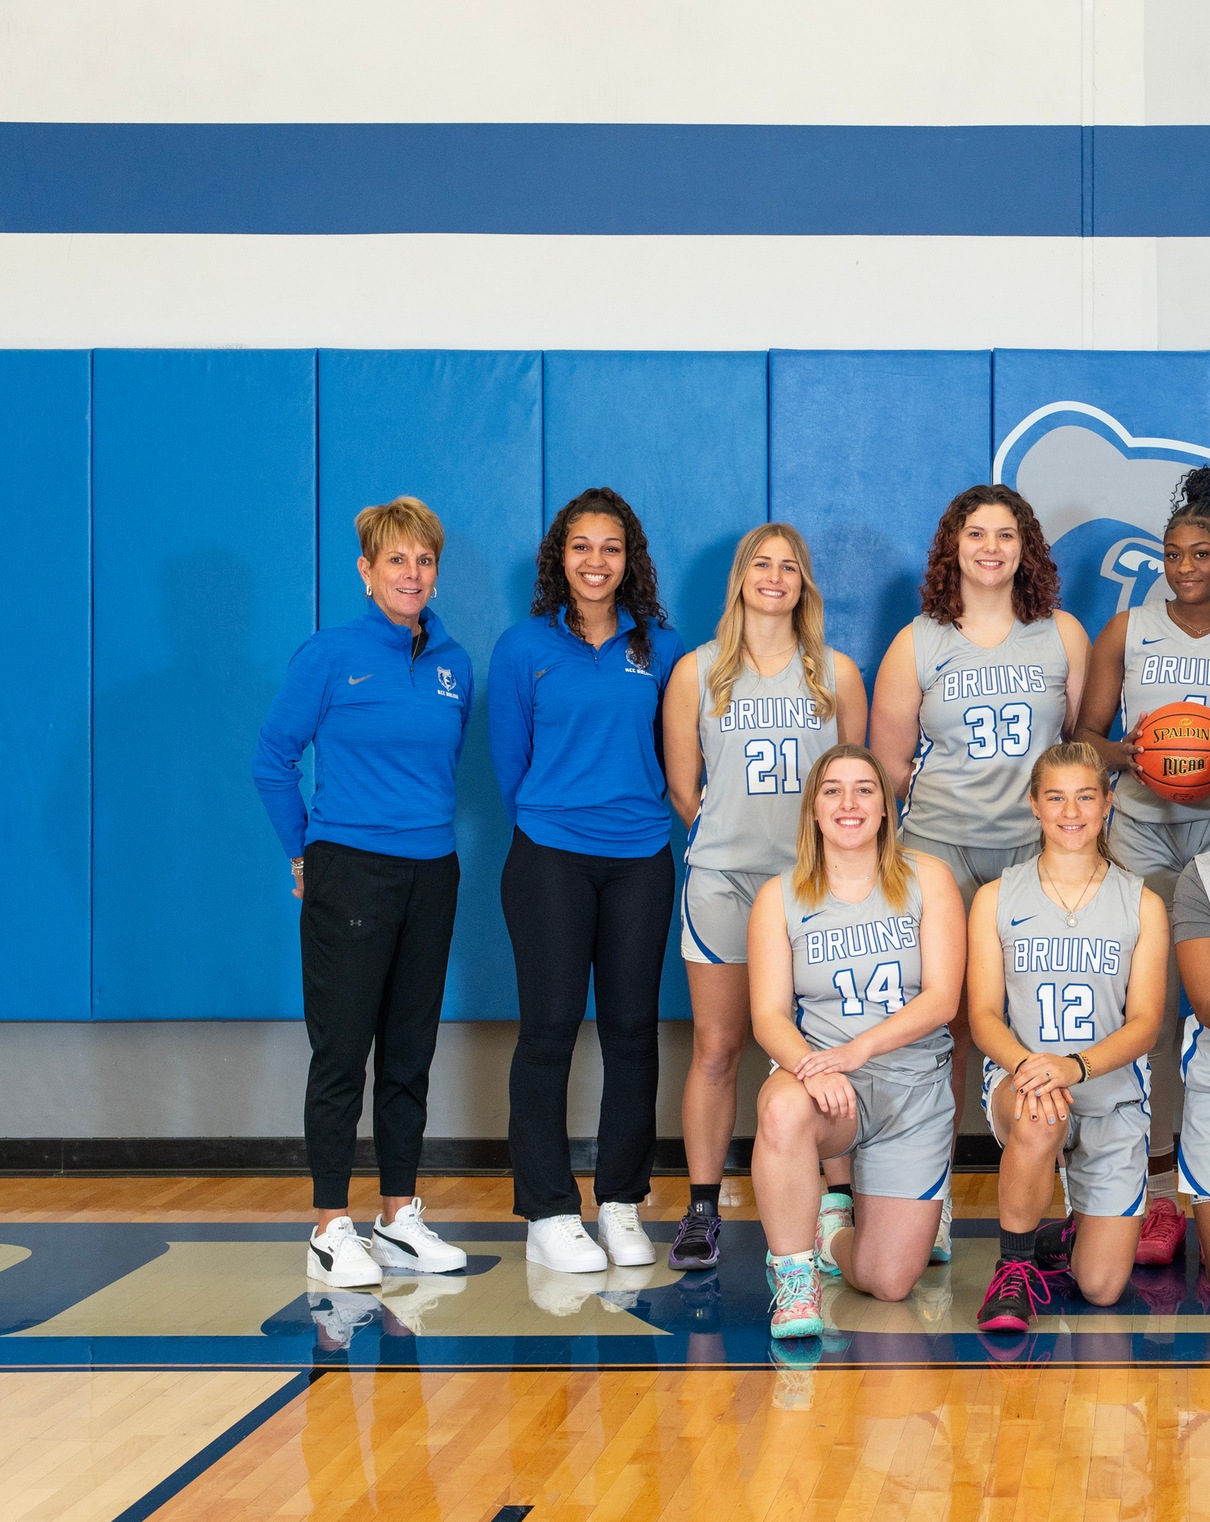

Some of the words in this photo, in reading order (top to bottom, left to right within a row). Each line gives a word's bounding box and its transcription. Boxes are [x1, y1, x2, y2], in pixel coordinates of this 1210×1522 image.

[943, 665, 1046, 702] BRUINS
[720, 697, 822, 733] BRUINS
[963, 702, 1032, 760] 33
[744, 738, 801, 795] 21
[1162, 755, 1206, 777] NJCAA
[806, 915, 917, 965] BRUINS
[1014, 937, 1121, 976] BRUINS
[832, 960, 905, 1016] 14
[1036, 983, 1095, 1042] 12
